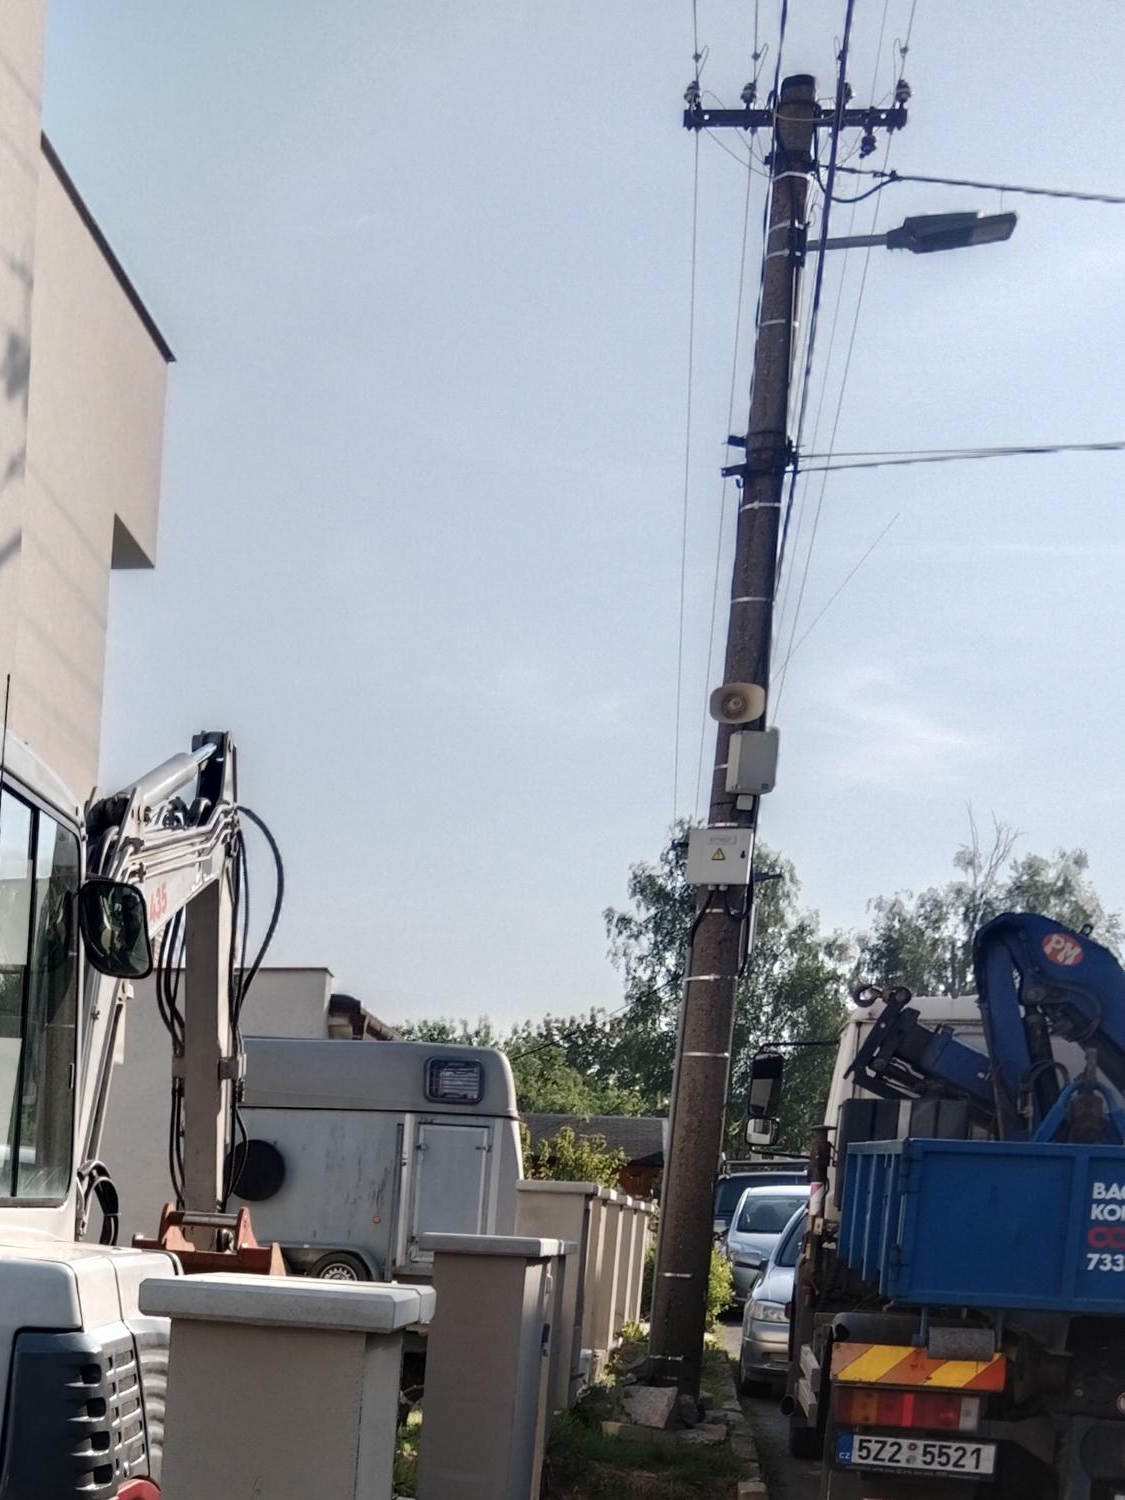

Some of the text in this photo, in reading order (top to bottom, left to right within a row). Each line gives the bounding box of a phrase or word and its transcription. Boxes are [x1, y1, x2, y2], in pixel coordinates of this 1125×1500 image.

[1043, 933, 1082, 966] PM
[1086, 1252, 1125, 1272] 733
[838, 1451, 851, 1460] CZ
[857, 1438, 982, 1470] 5Z2 5521
